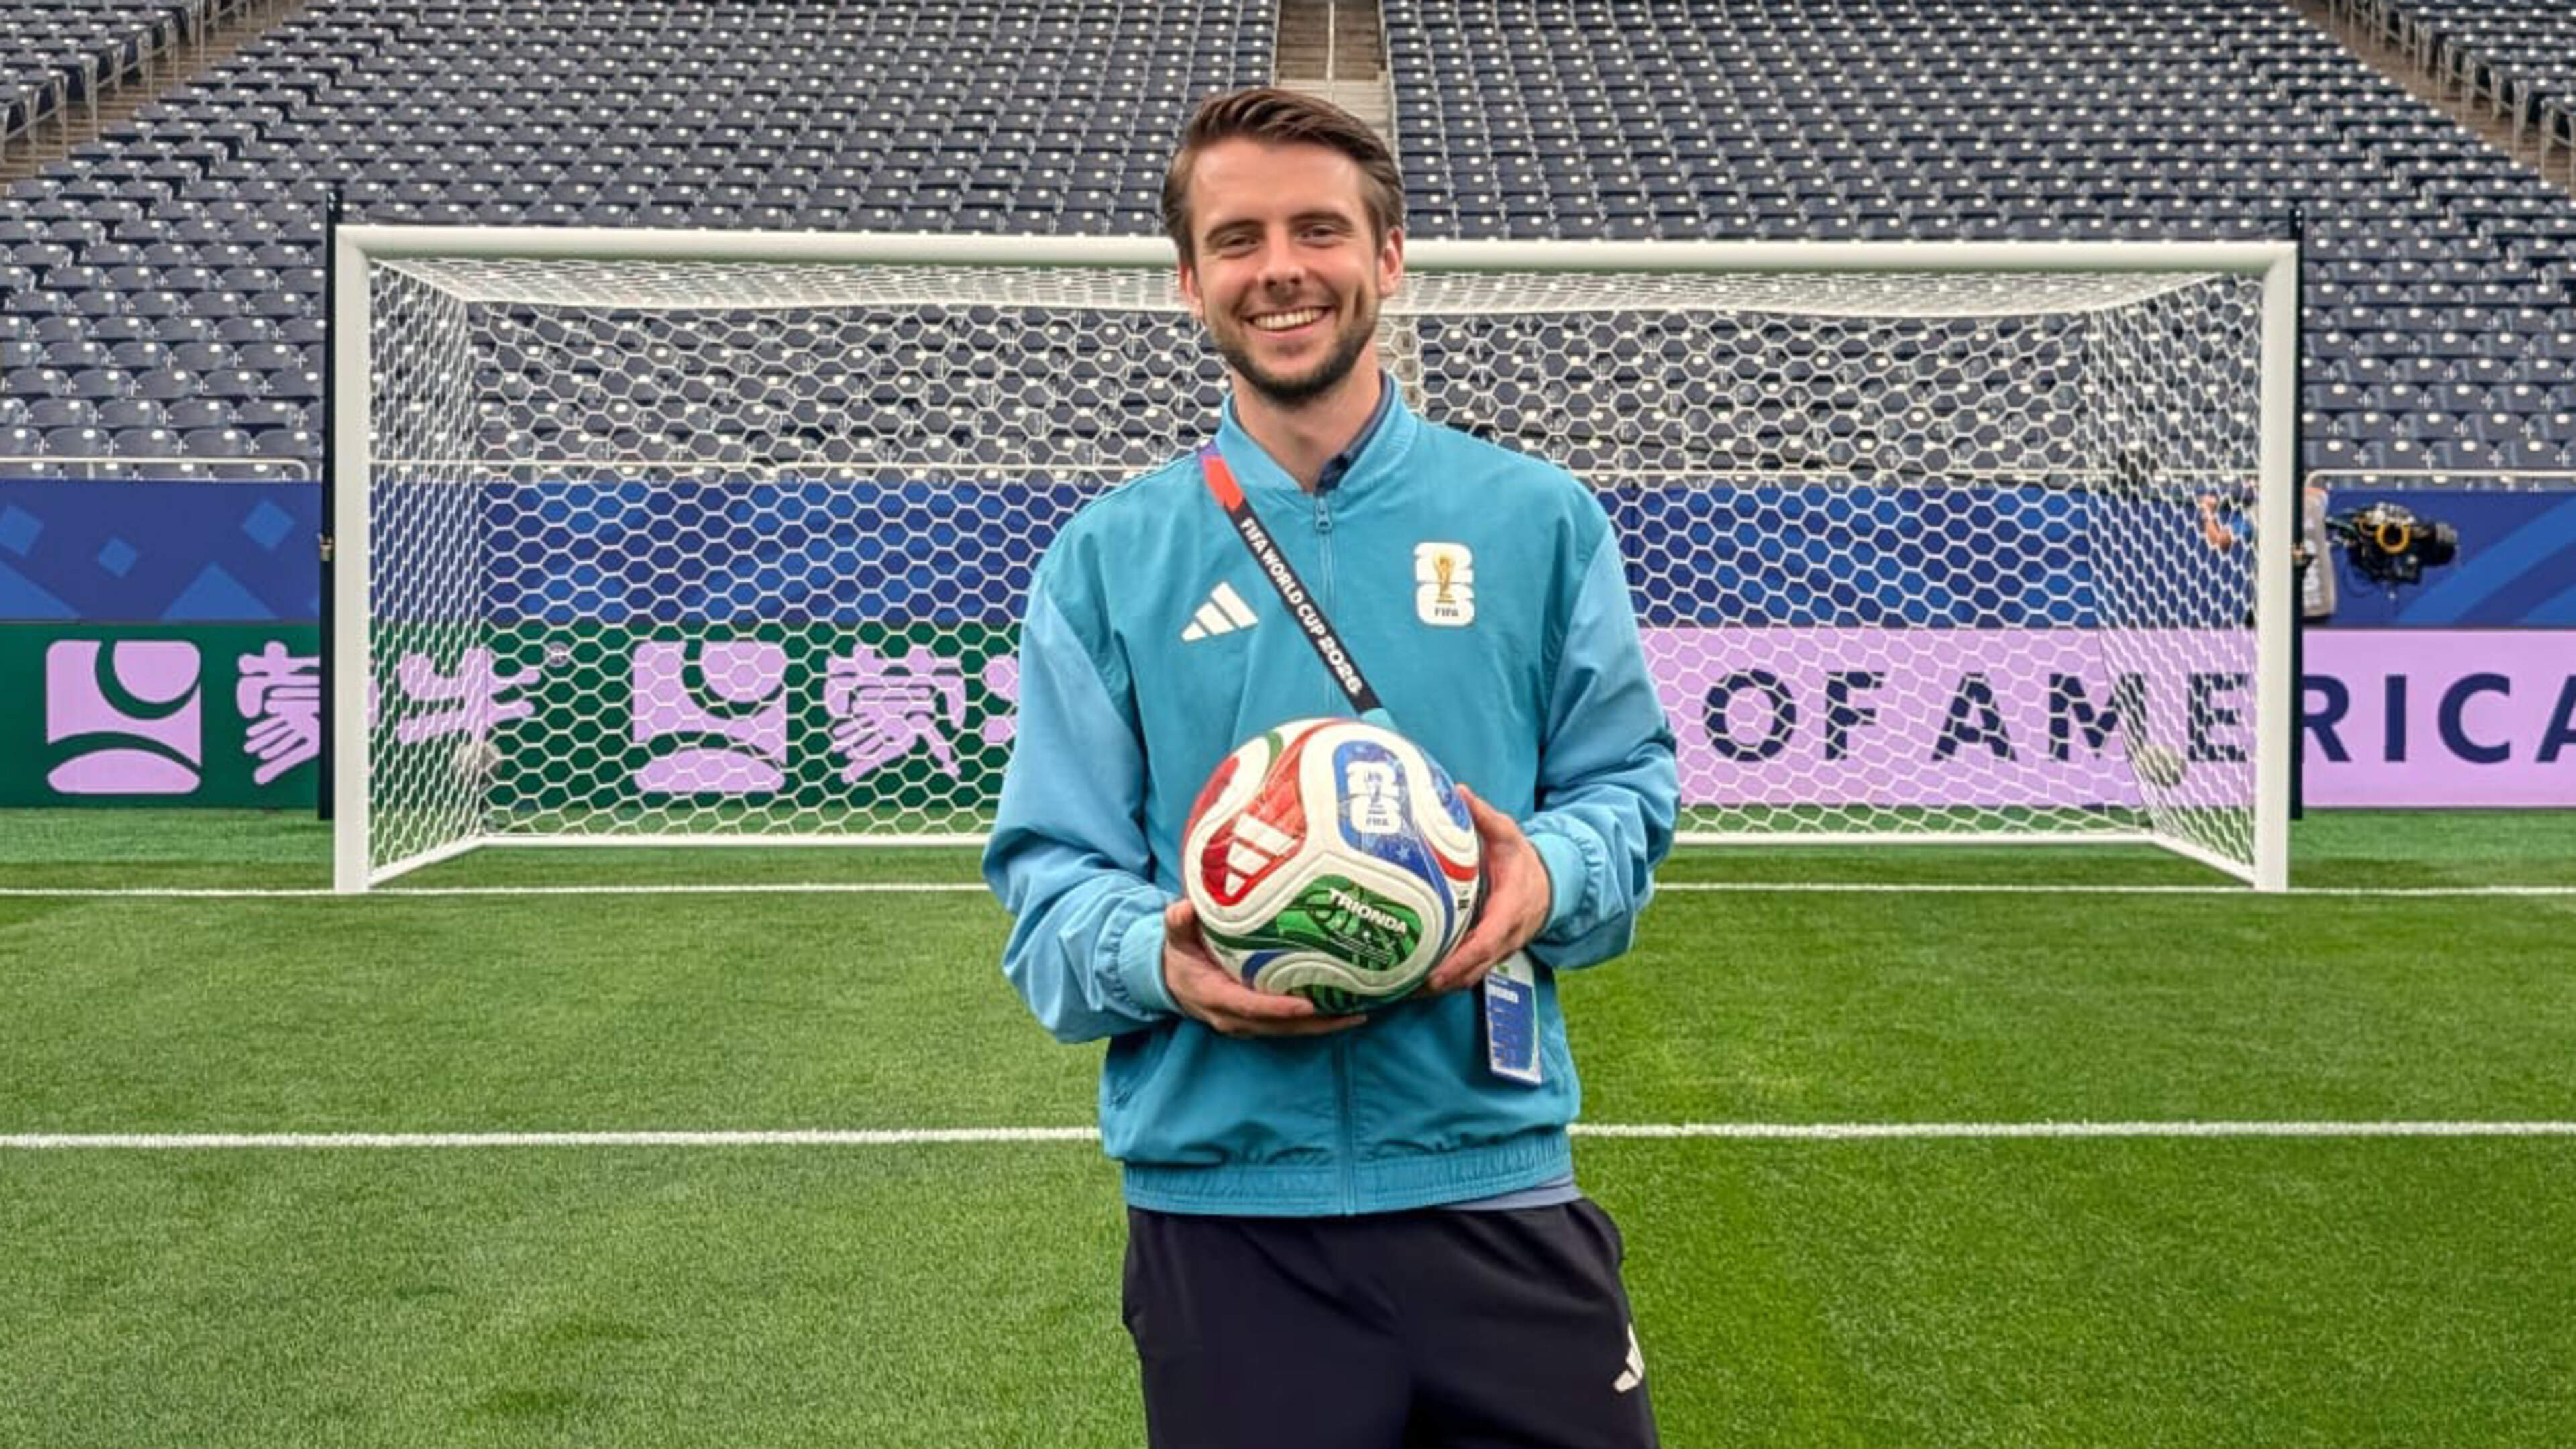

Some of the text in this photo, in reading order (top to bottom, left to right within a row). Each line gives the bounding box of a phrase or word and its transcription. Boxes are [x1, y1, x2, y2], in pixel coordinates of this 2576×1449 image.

[1241, 517, 1363, 696] FIFA WORLD CUP 2026
[1434, 607, 1459, 616] FIFA
[824, 643, 1021, 784] 蒙
[1703, 668, 1884, 763] OF
[1329, 887, 1407, 934] TRIONDA
